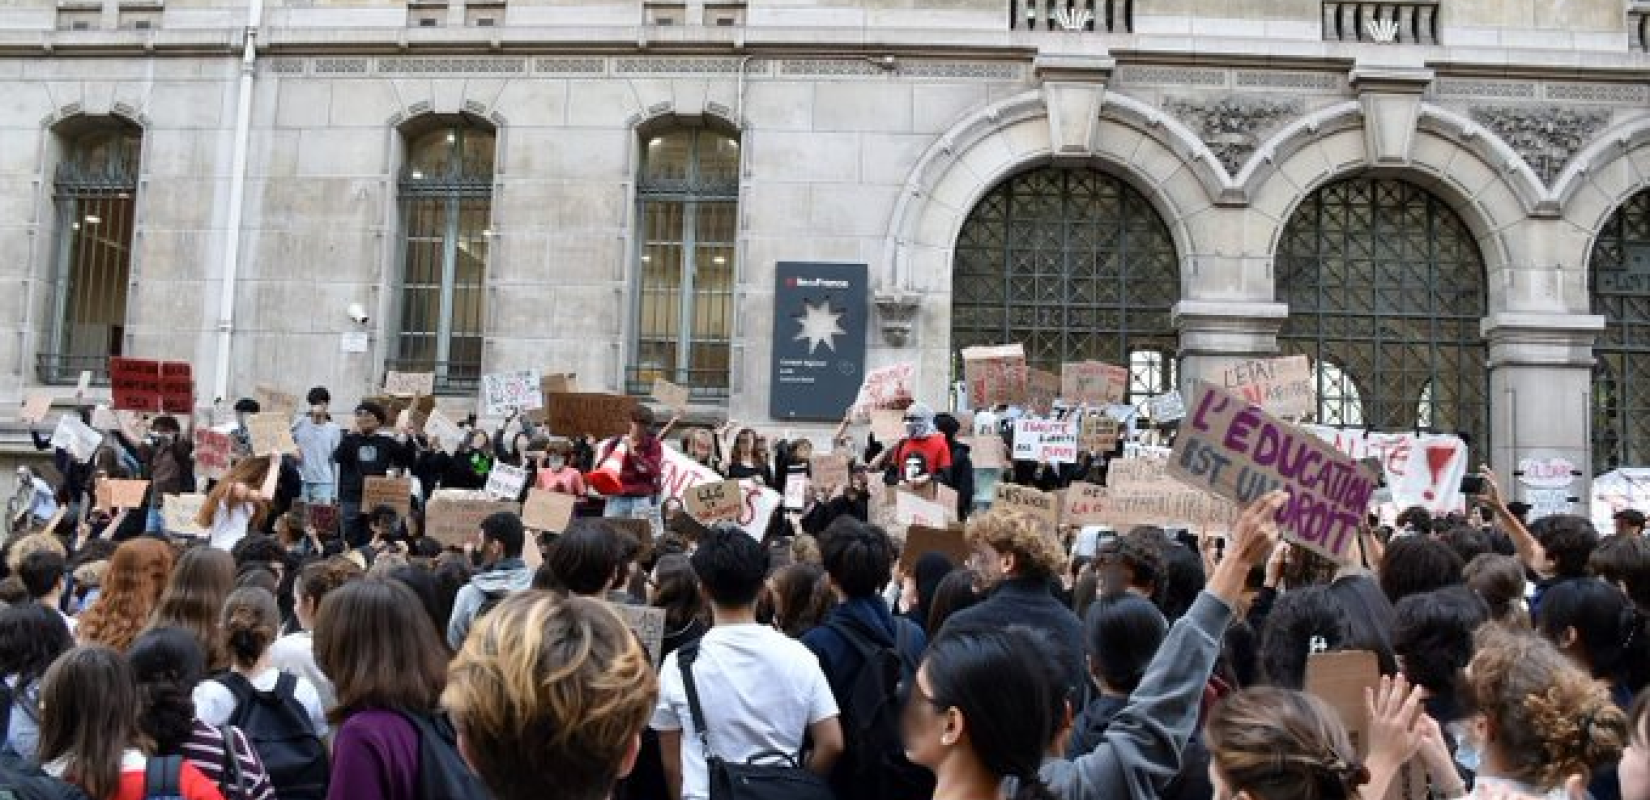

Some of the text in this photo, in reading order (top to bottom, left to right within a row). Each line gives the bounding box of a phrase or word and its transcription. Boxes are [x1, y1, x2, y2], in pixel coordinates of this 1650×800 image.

[1180, 437, 1232, 486] EST
[1192, 389, 1375, 518] L'ÉDUCATION
[1274, 484, 1362, 555] DROIT
